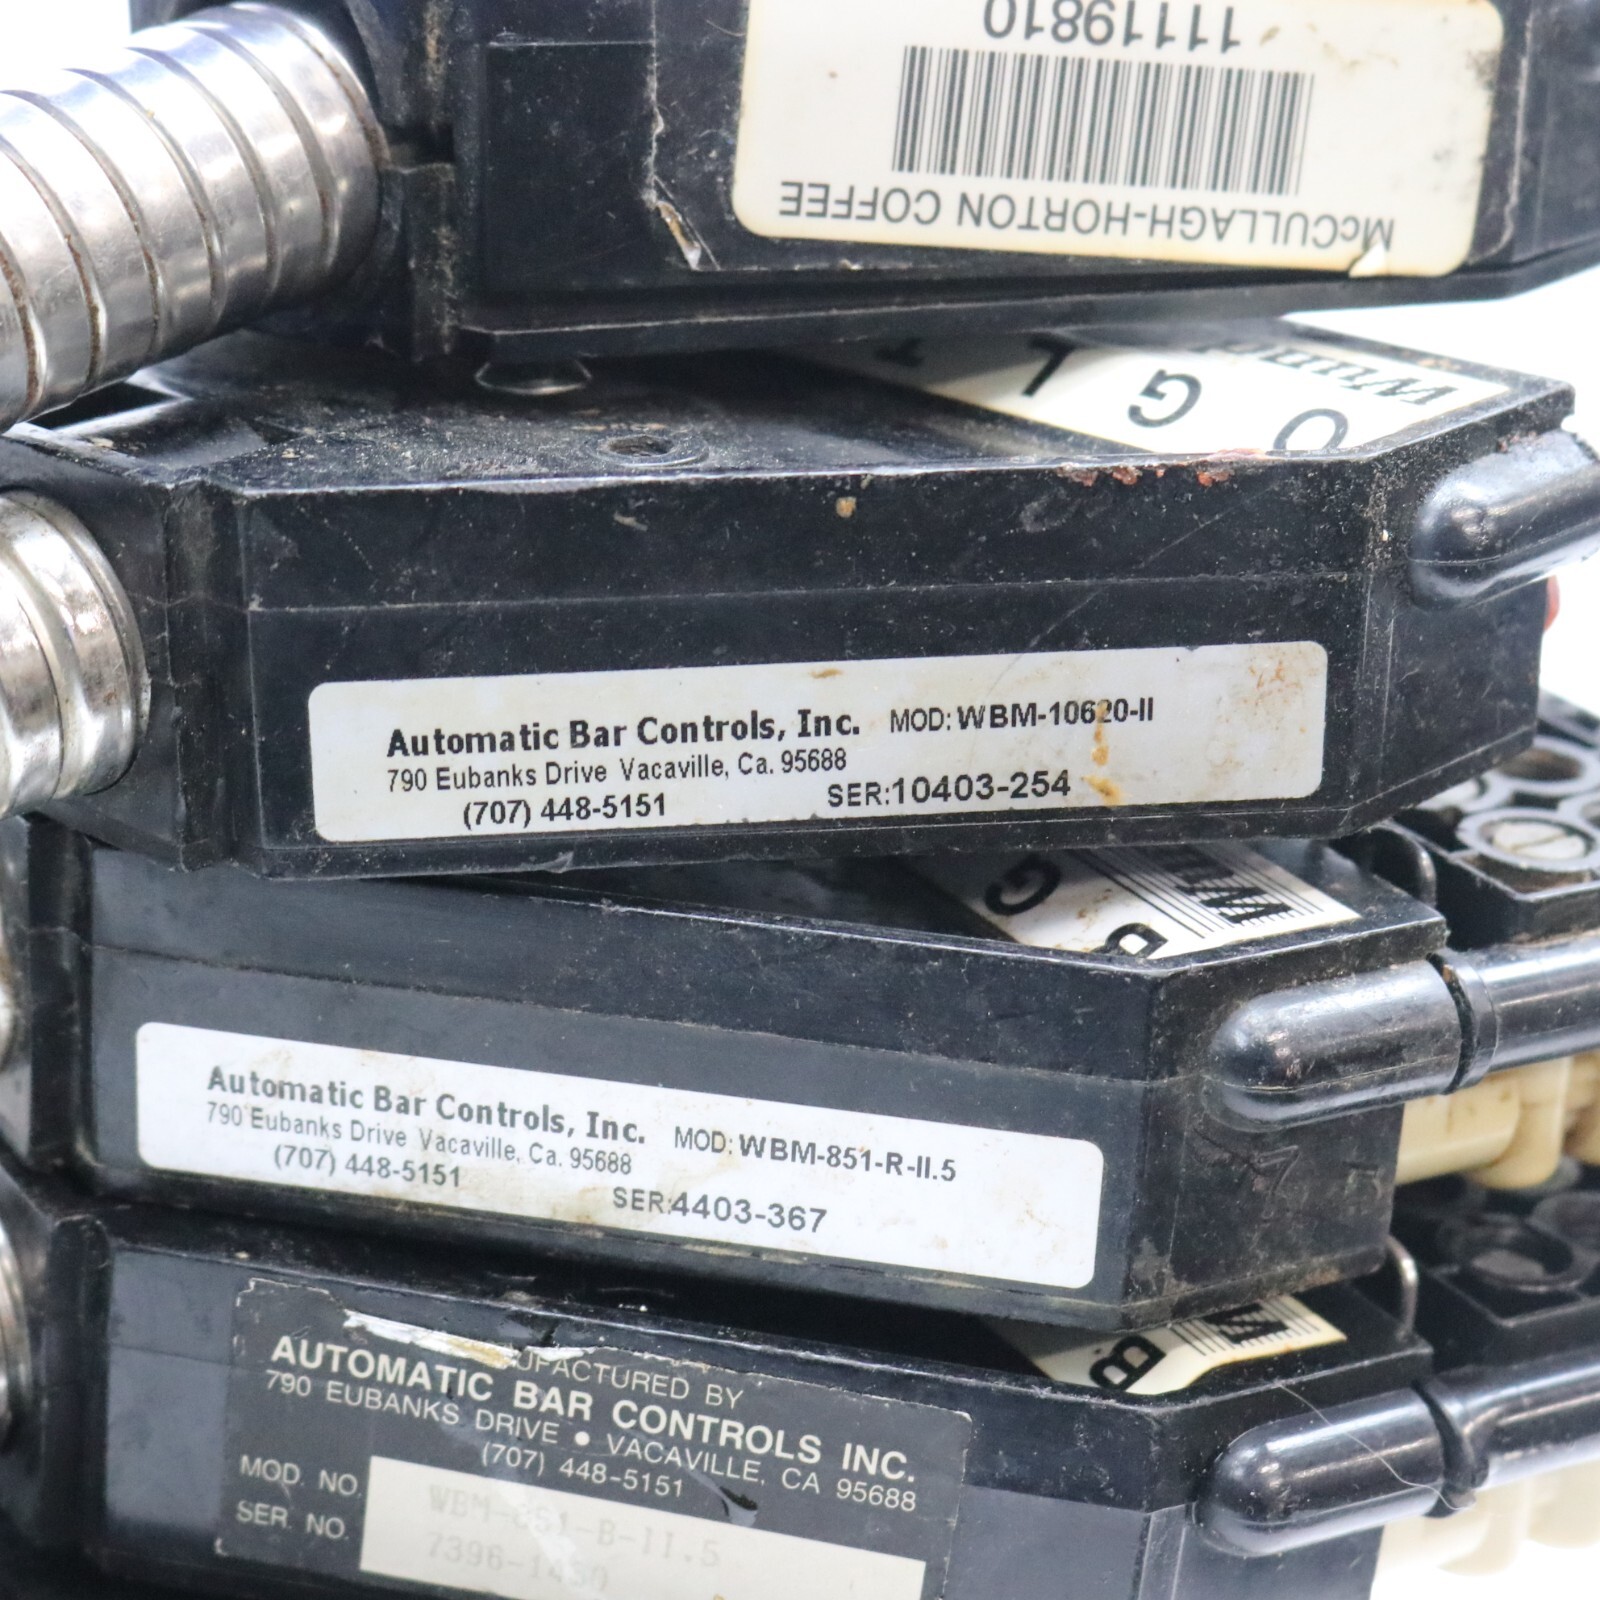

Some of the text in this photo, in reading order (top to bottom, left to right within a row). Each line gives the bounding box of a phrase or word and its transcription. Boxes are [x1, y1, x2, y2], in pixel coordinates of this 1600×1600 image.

[983, 0, 1241, 56] 11119810
[779, 180, 1395, 250] McCULLAGH-HORTON COFFEE
[1128, 369, 1201, 428] G
[387, 708, 861, 757] Automatic Bar Controls, Inc.
[387, 748, 848, 793] 790 Eubanks Drive Vacaville, Ca. 95688
[462, 792, 666, 830] (707) 448-5151
[207, 1065, 645, 1145] Automatic Bar Controls, Inc.
[207, 1101, 632, 1176] 790 Eubanks Drive Vacaville, Ca. 95688
[274, 1144, 461, 1188] (707) 448-5151
[516, 1351, 744, 1410] UFACTURED BY
[270, 1335, 916, 1484] AUTOMATIC BAR CONTROLS INC.
[266, 1370, 917, 1512] 790 EUBANKS DRIVE VACAVILLE, CA 95688
[482, 1441, 683, 1498] (707) 448-5151
[318, 1469, 362, 1498] NO.
[306, 1512, 349, 1542] NO.
